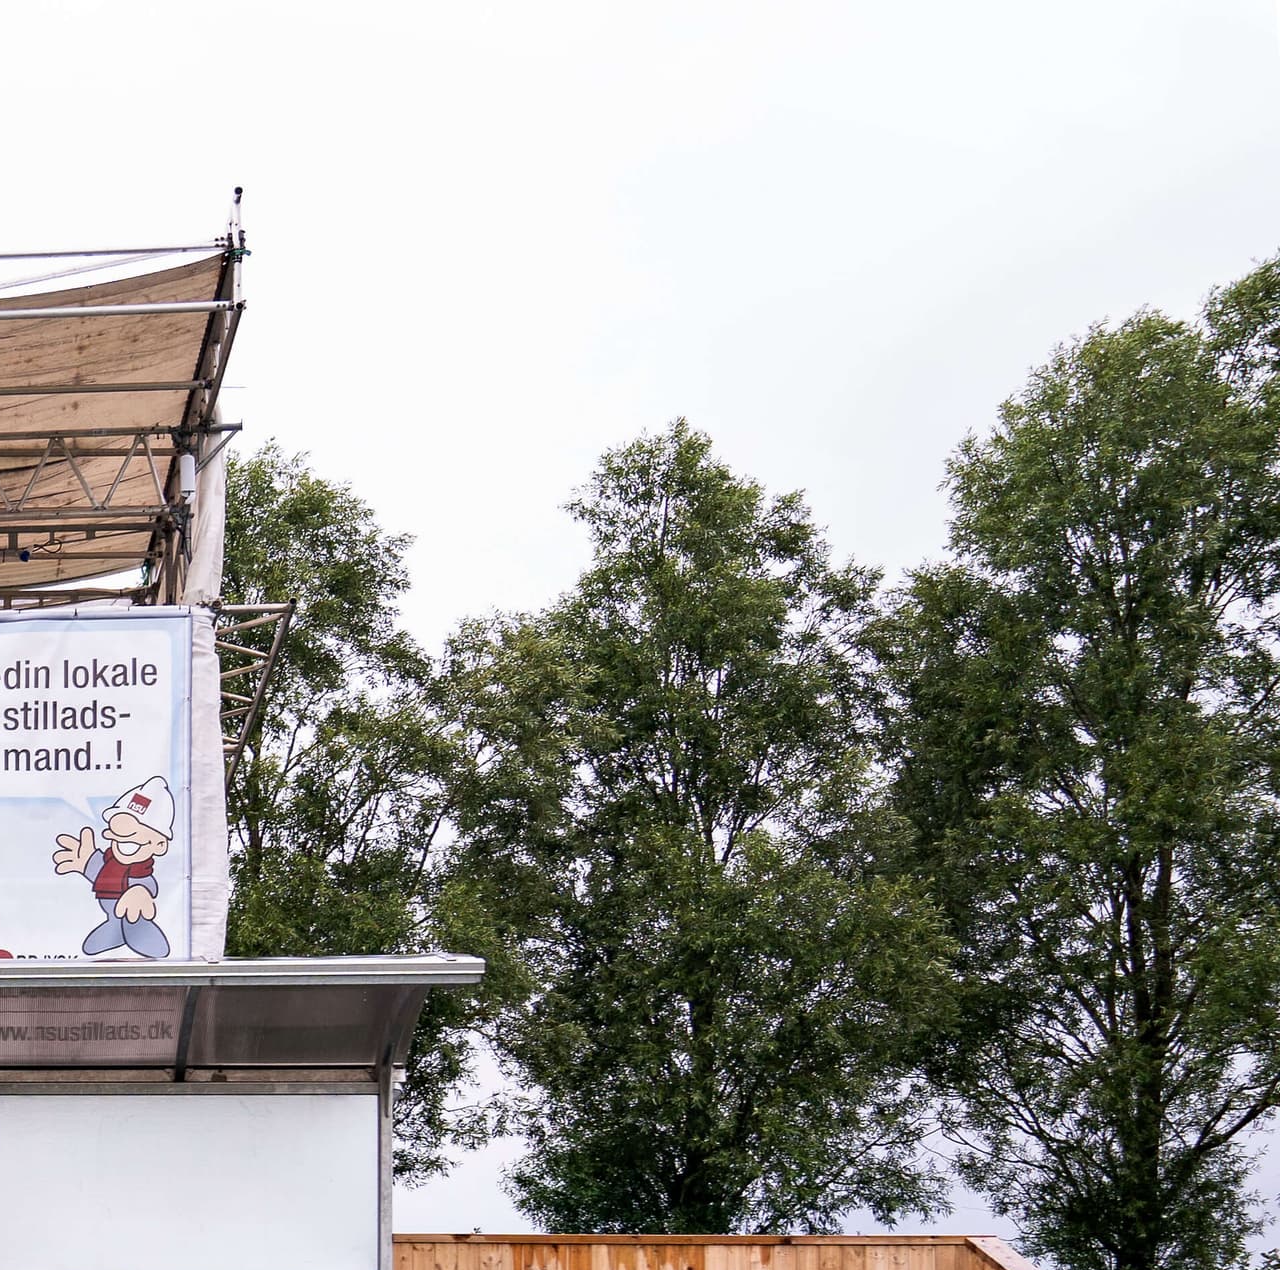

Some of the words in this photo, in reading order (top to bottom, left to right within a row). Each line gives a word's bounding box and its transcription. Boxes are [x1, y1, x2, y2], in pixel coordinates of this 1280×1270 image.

[63, 657, 158, 689] lokale
[3, 699, 131, 731] stillads-
[3, 740, 123, 772] mand..!
